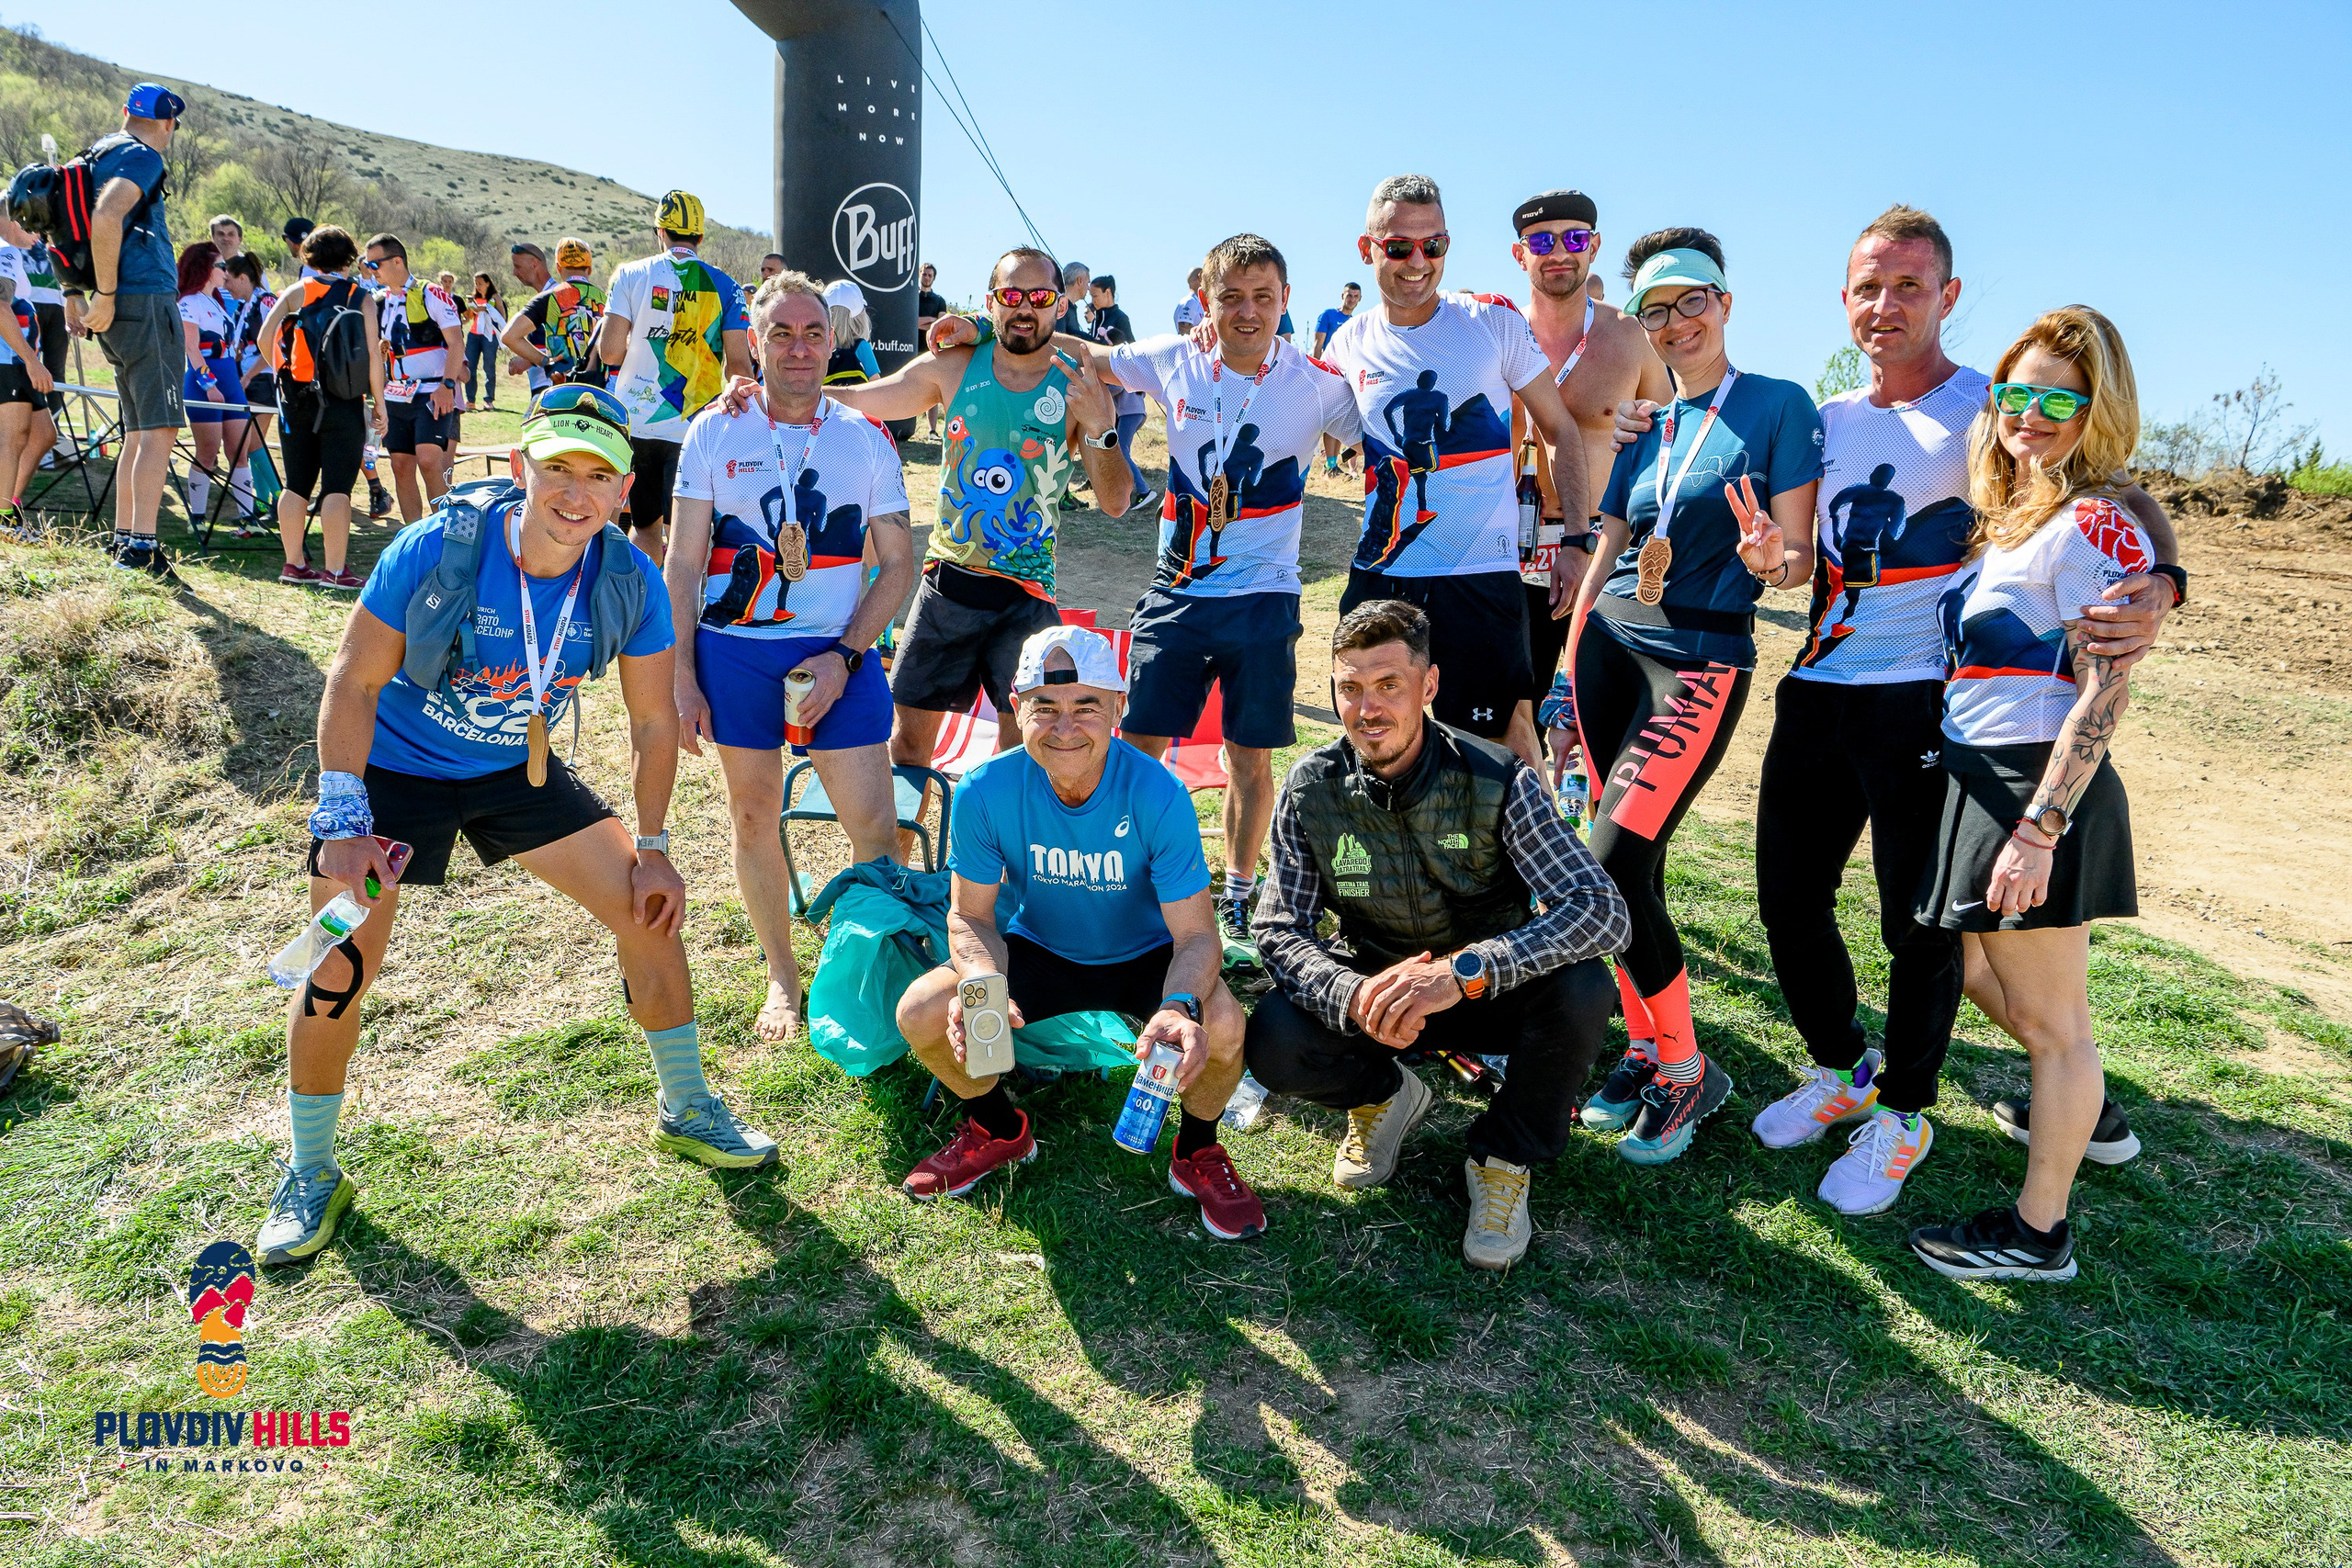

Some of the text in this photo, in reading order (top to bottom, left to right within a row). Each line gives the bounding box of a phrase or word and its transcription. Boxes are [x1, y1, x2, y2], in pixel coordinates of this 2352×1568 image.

[837, 74, 916, 94] LIVE
[838, 103, 916, 121] MORE
[859, 132, 904, 146] NOW
[553, 420, 570, 428] LION
[595, 425, 614, 440] HEART
[477, 605, 497, 615] URICH
[477, 614, 501, 626] RATÓ
[473, 624, 515, 639] CELONA
[422, 702, 526, 748] BARCELONA
[1612, 666, 1732, 793] PUMA
[1029, 843, 1125, 884] TOKYO
[1032, 874, 1060, 886] TOKYO
[1338, 887, 1371, 898] FINISHER
[1661, 1081, 1704, 1145] DYNAFIT
